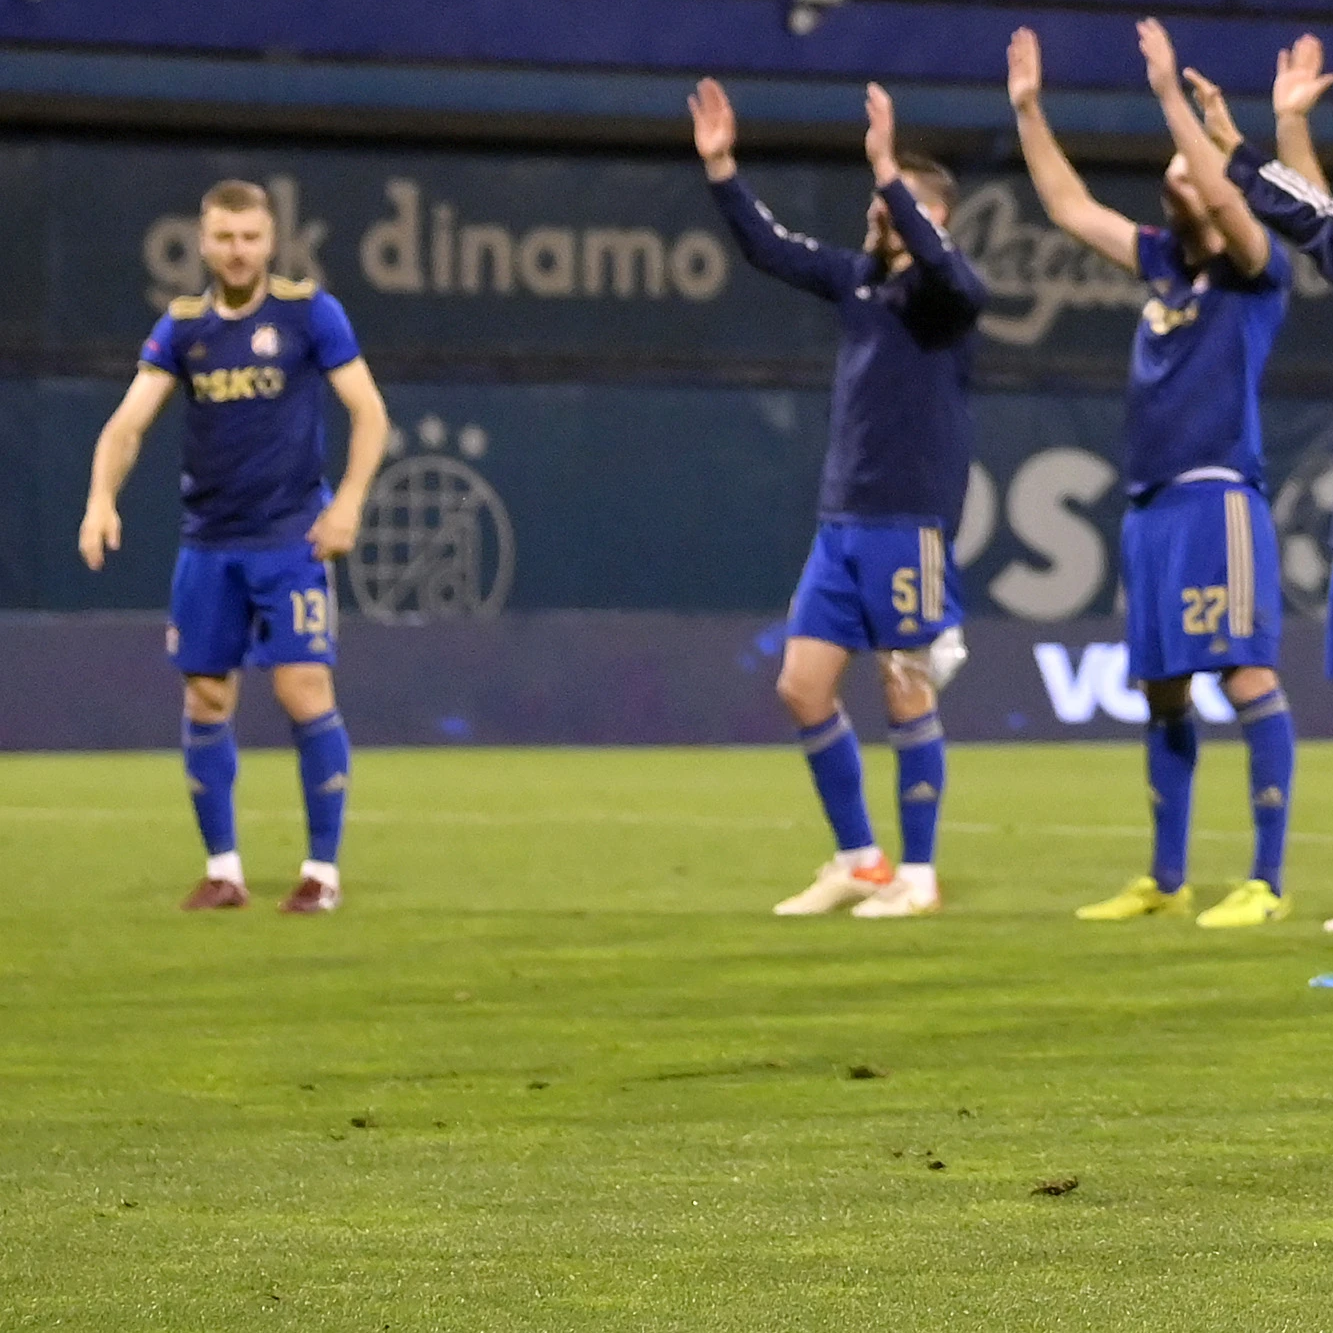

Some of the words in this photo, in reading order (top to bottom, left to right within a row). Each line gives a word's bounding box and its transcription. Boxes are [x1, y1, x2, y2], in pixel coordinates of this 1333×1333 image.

[142, 174, 332, 312] gk
[359, 176, 729, 303] dinamo
[290, 588, 328, 635] 13
[891, 567, 918, 615] 5
[1181, 585, 1228, 635] 27
